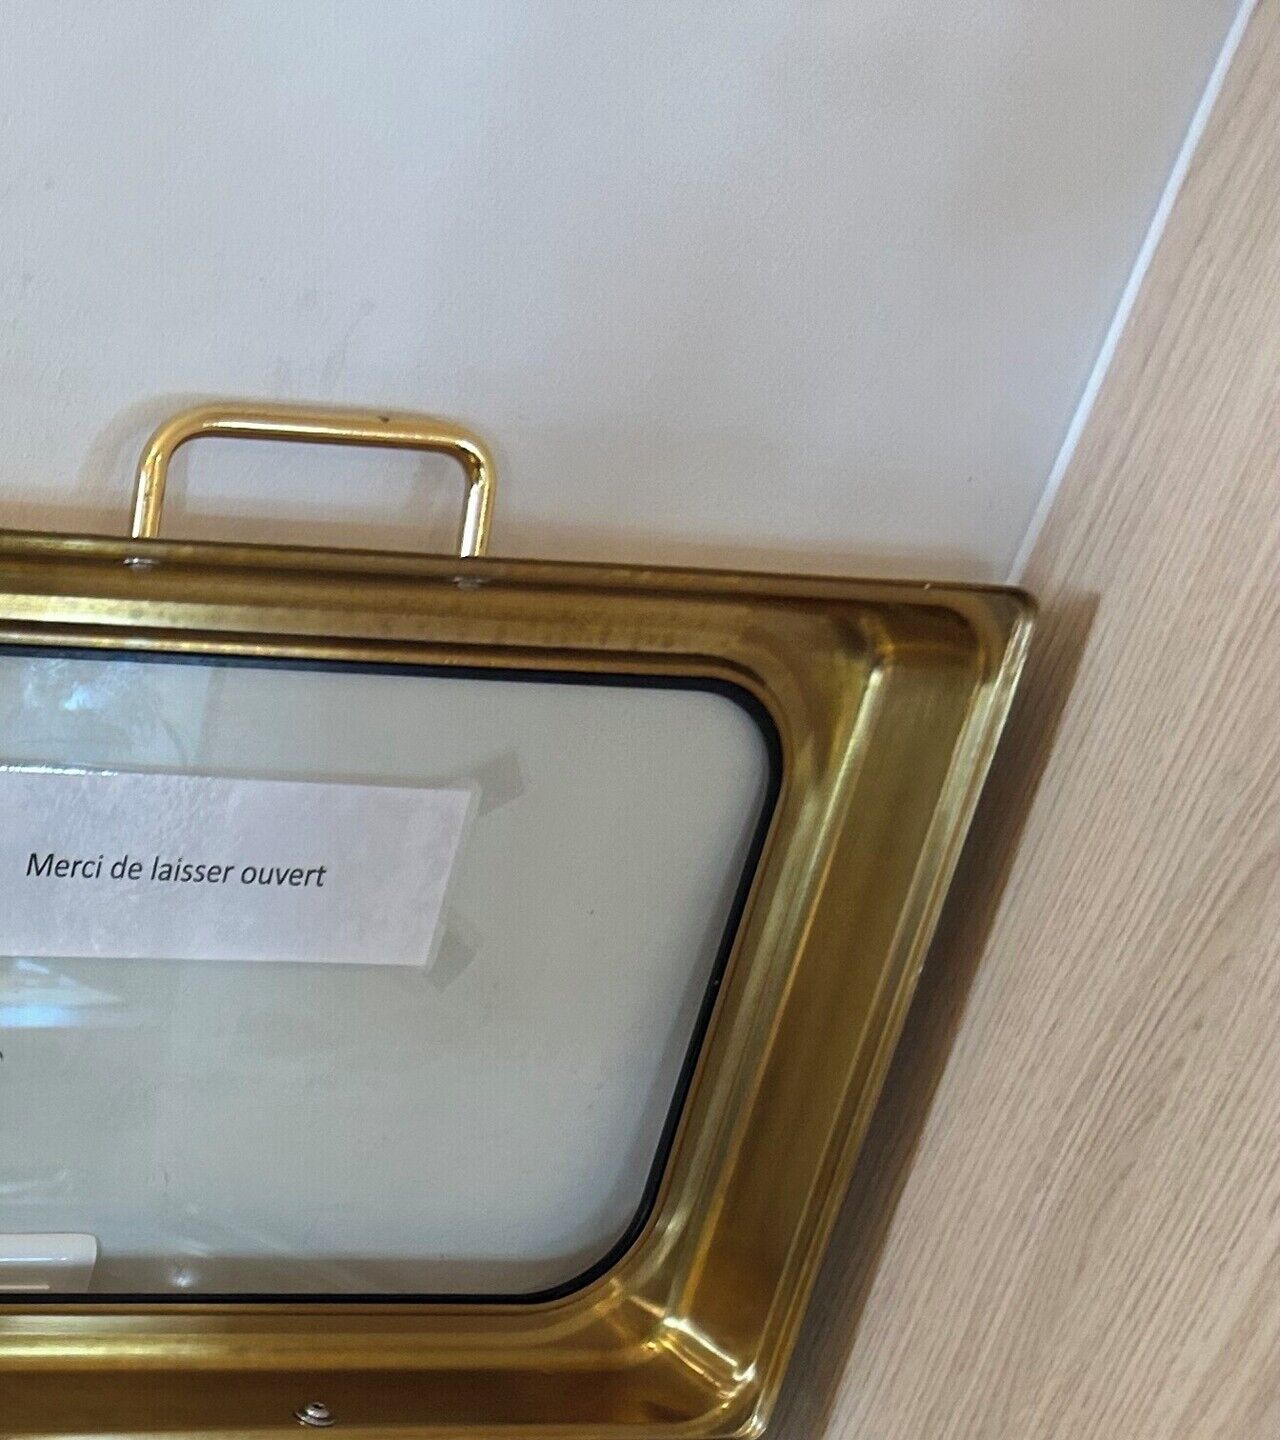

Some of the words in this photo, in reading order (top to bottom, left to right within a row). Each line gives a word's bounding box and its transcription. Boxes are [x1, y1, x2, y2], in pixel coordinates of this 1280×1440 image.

[26, 853, 103, 880] Merci
[110, 854, 143, 881] de
[150, 855, 235, 884] laisser
[240, 864, 328, 888] ouvert
